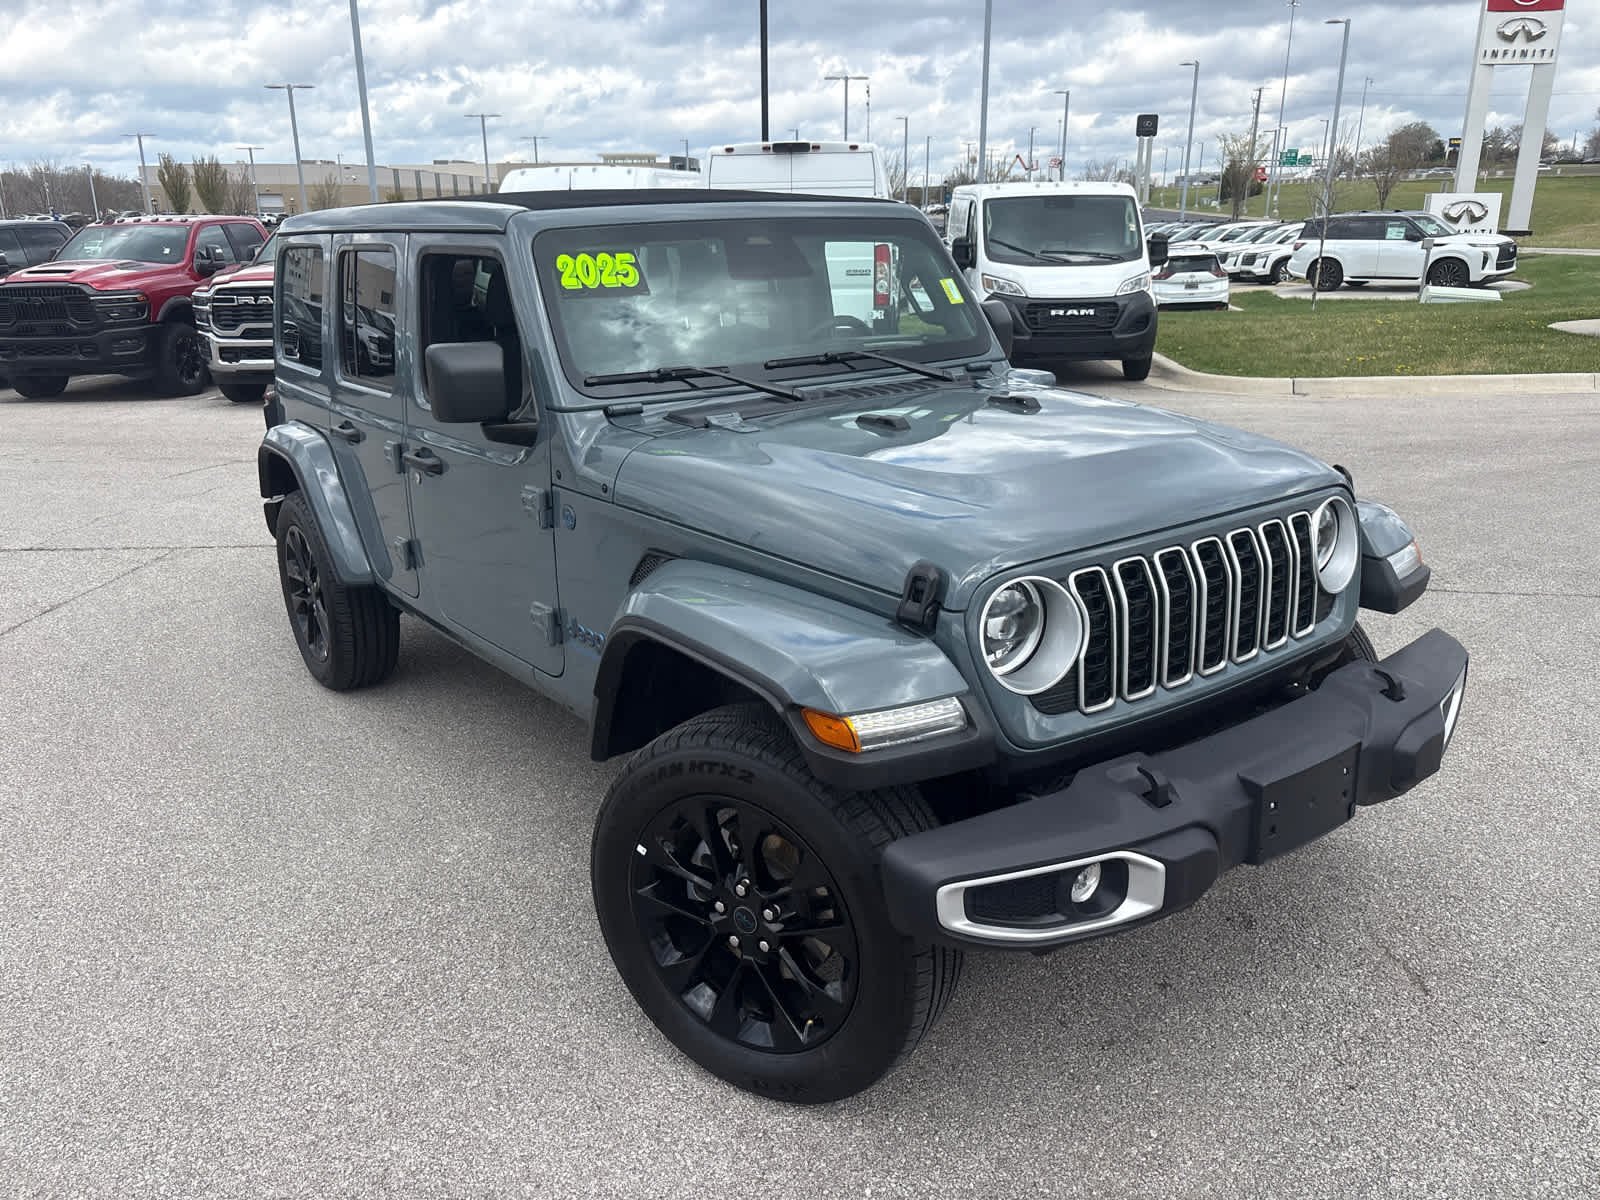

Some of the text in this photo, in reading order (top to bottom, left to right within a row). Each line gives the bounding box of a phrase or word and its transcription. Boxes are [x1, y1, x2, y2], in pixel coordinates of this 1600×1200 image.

[1482, 48, 1555, 59] INFINITI
[556, 252, 640, 289] 2025
[236, 296, 274, 305] RA
[1050, 308, 1095, 316] RAM
[688, 759, 755, 785] HTX2
